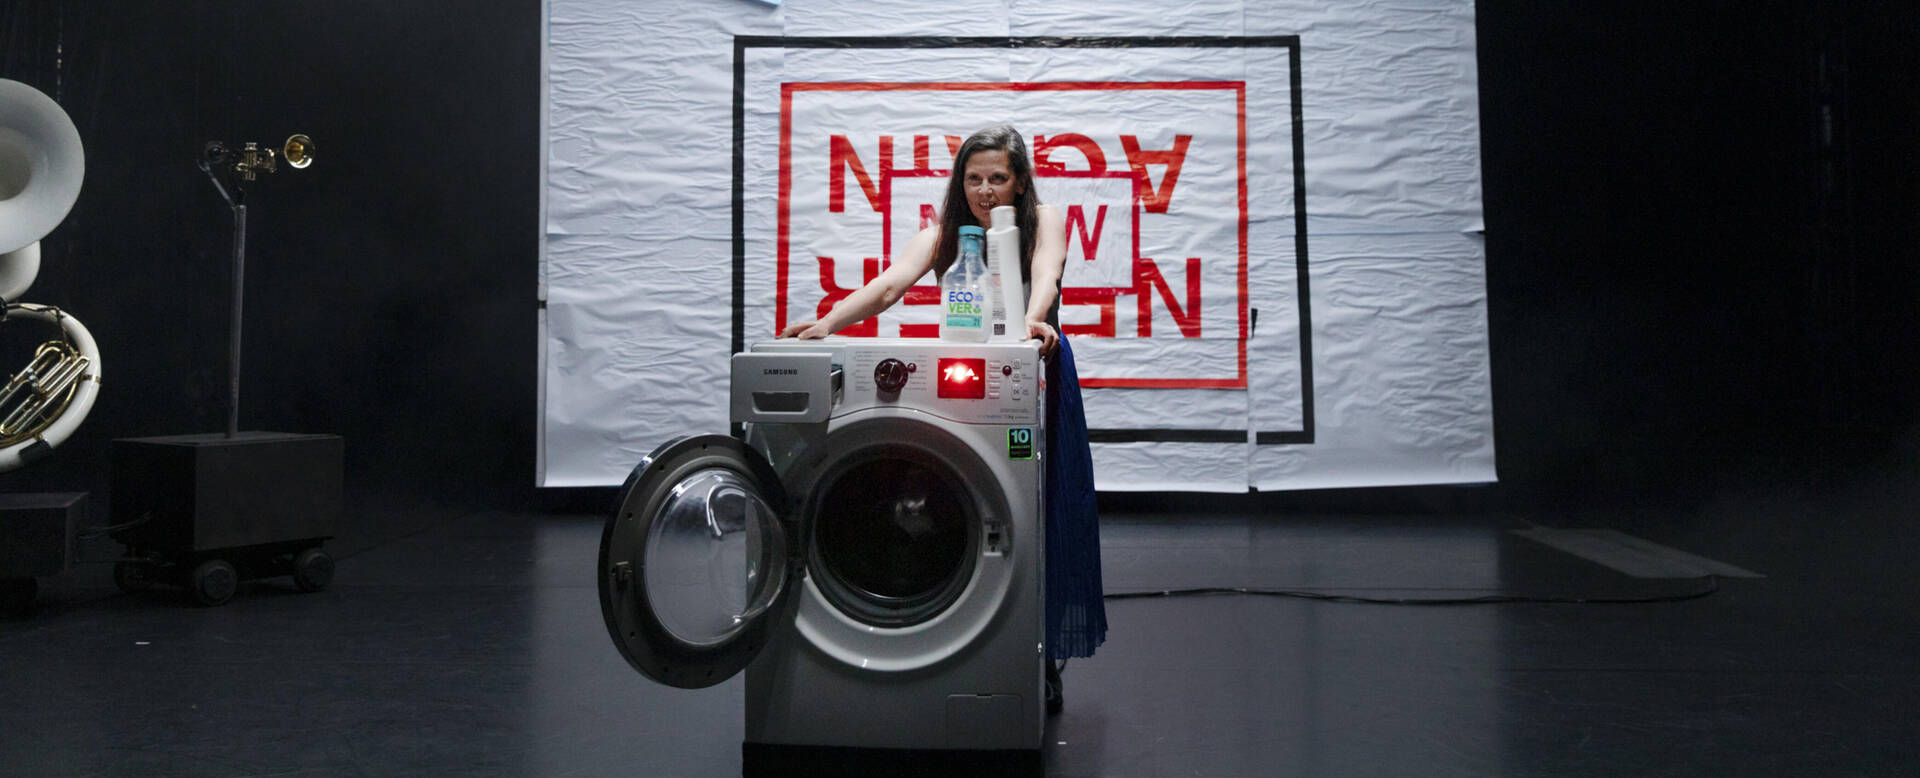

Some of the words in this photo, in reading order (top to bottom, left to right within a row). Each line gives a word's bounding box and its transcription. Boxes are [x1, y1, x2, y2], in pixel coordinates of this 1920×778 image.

[830, 134, 1191, 213] AGN
[818, 257, 1201, 338] NER
[949, 291, 973, 302] ECO
[949, 302, 973, 314] VER
[763, 368, 798, 376] SAMSUNG
[1010, 429, 1029, 444] 10
